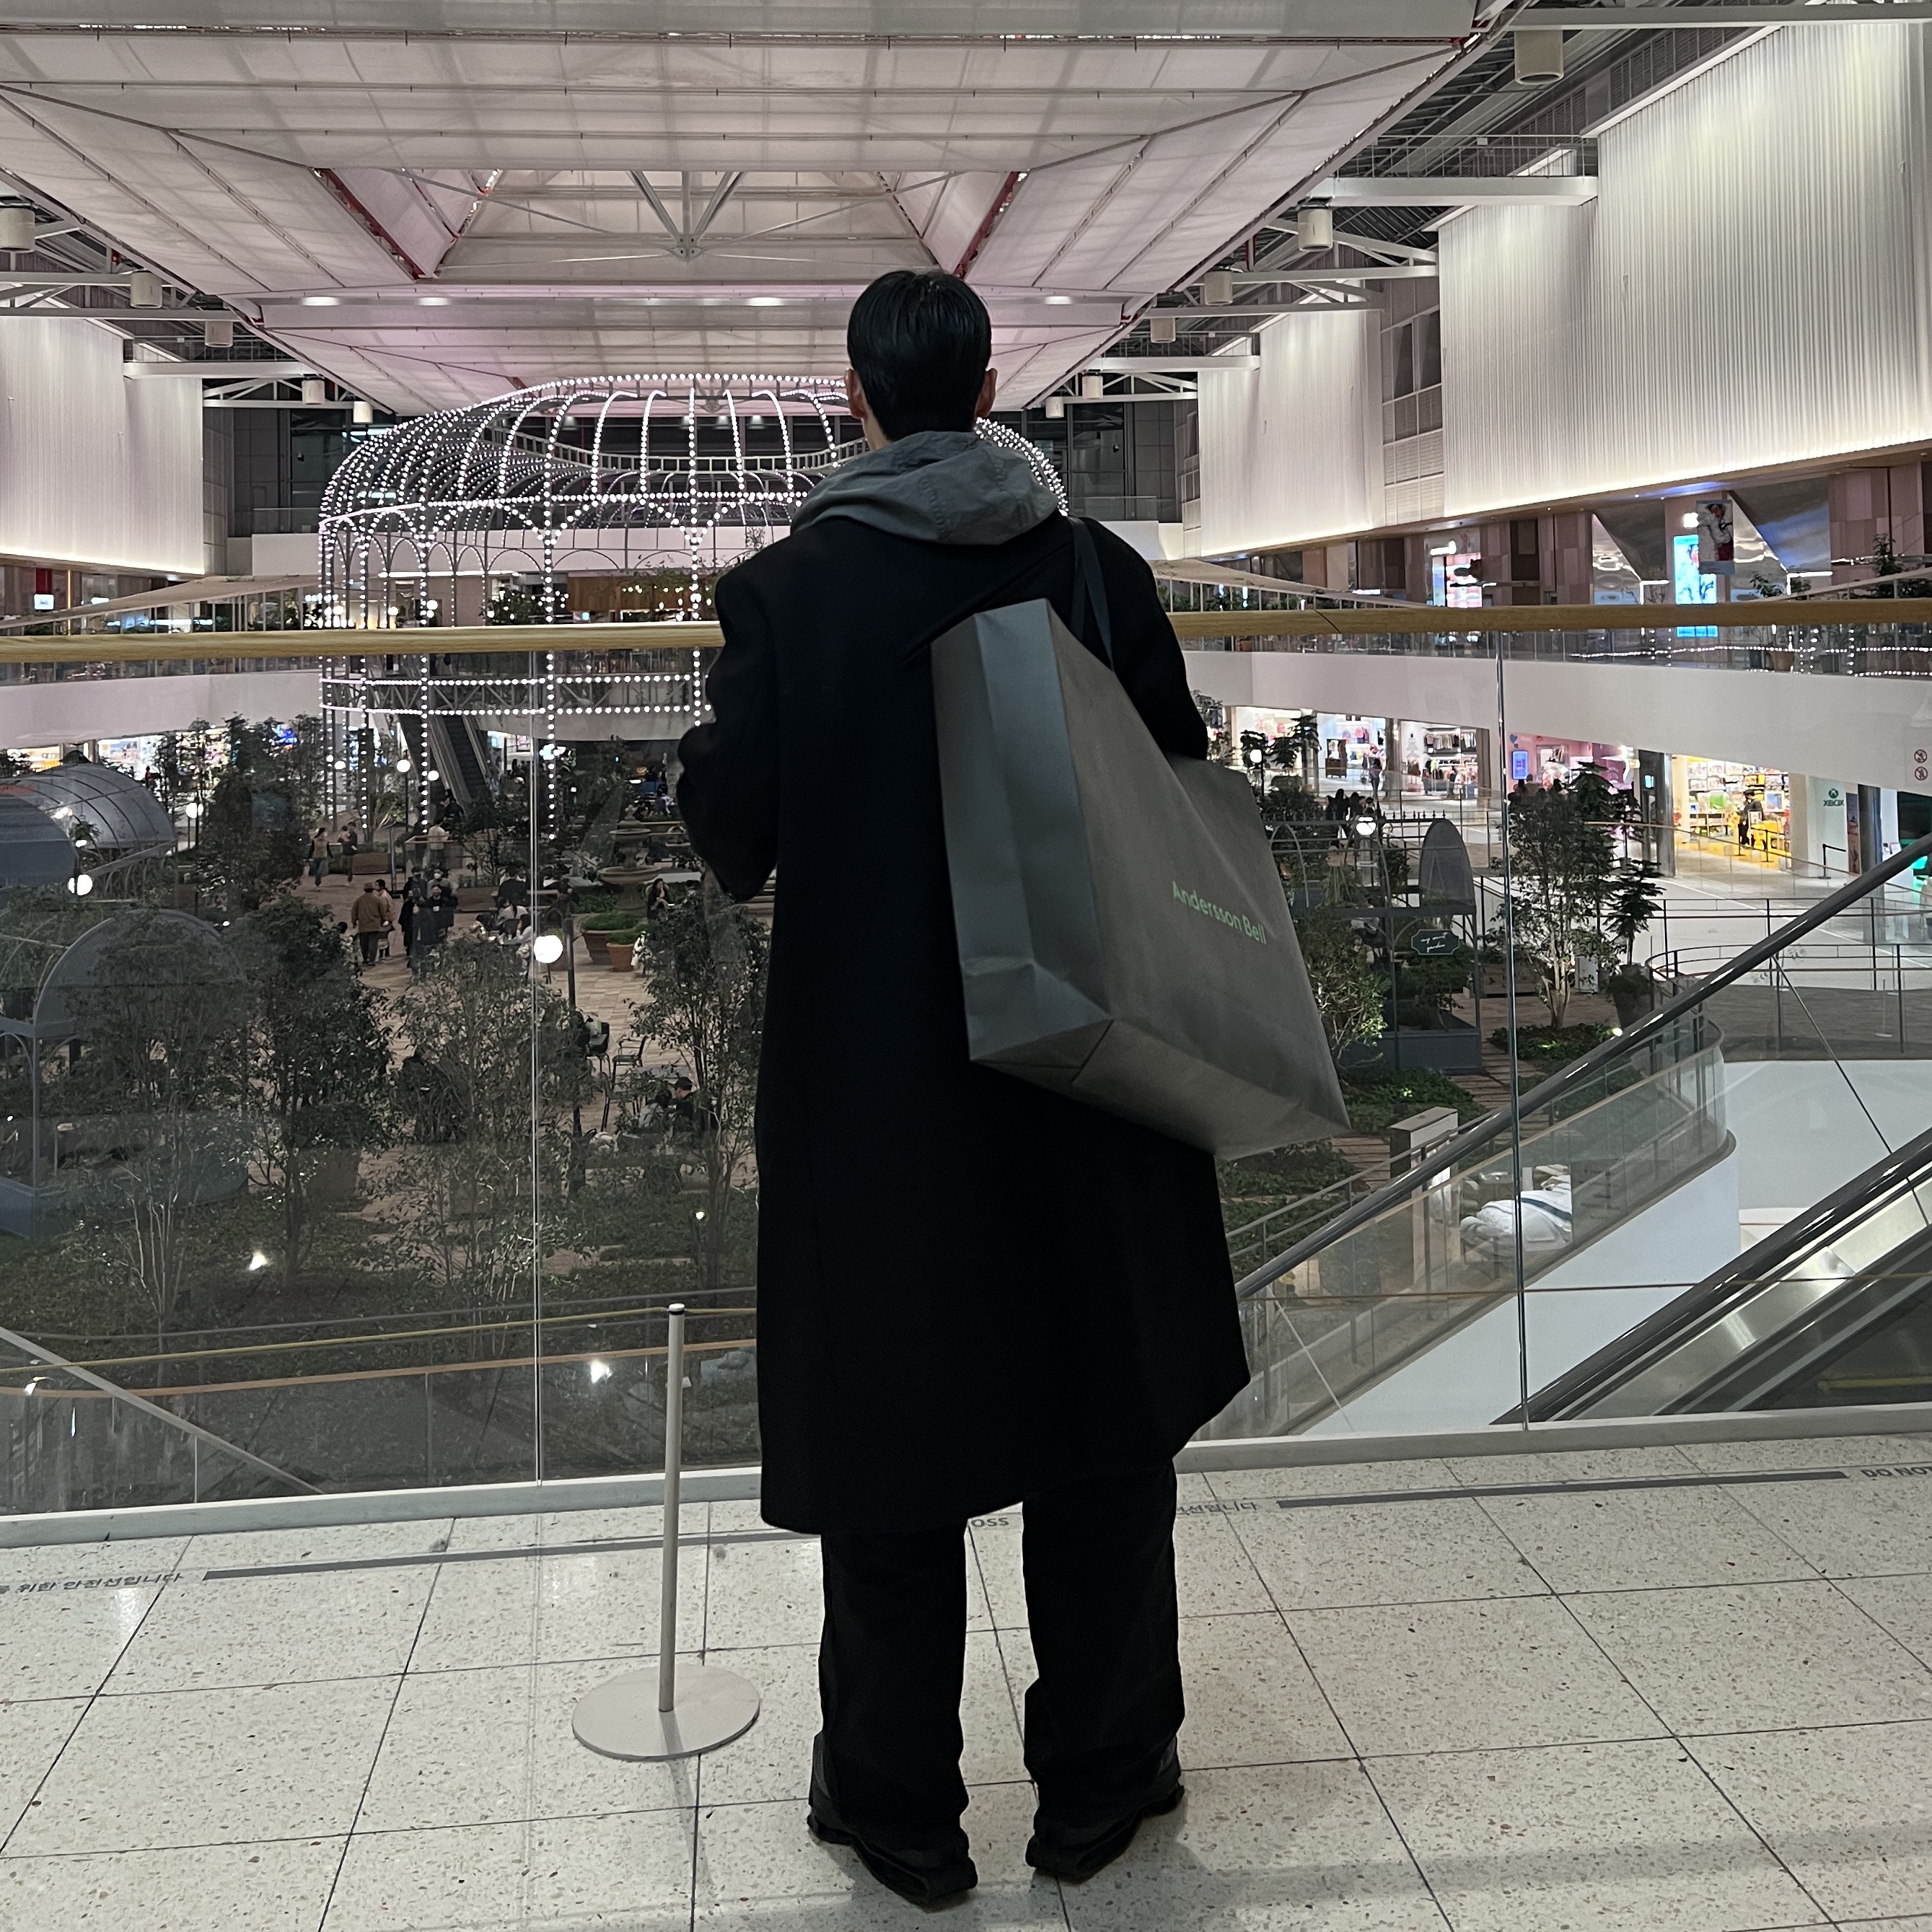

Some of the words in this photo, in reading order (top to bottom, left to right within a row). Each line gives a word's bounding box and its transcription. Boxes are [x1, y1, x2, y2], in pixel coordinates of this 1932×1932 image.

[1172, 879, 1243, 932] Andersson
[1242, 915, 1267, 945] Bell
[1860, 1468, 1894, 1477] DO
